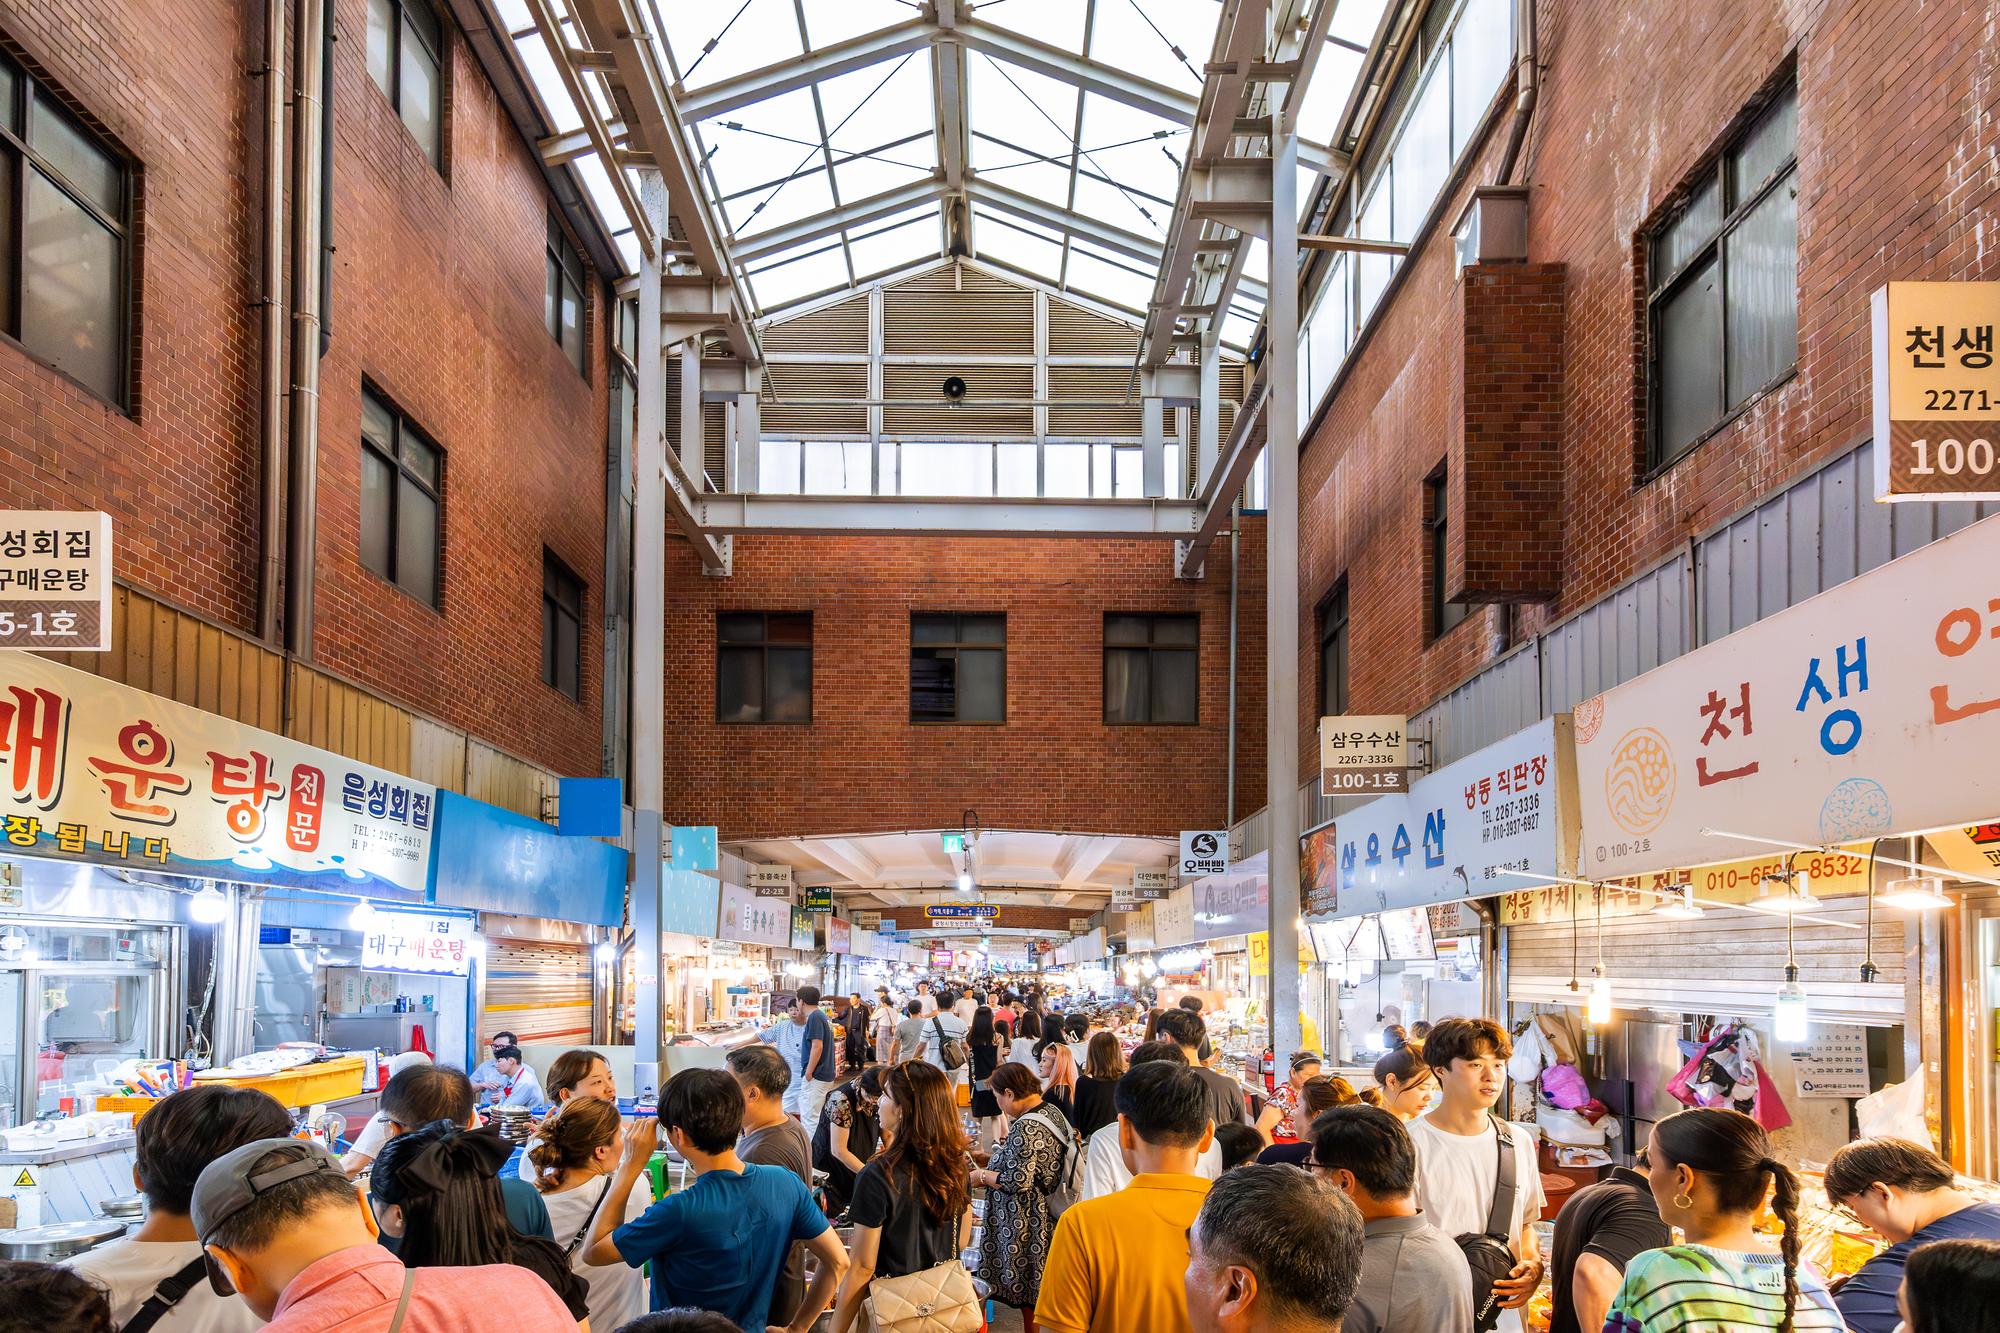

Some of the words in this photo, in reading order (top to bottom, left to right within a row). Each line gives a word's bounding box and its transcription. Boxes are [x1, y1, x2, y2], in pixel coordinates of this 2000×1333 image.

[1905, 325, 1994, 369] 천생
[0, 529, 91, 559] 성회집
[0, 609, 79, 636] 5-1호
[1331, 730, 1401, 749] 삼우수산
[1337, 754, 1394, 765] 2267-3336
[1332, 771, 1400, 788] 100-1호
[1464, 776, 1492, 811] 냉동
[1497, 753, 1548, 795] 직판장
[289, 771, 320, 847] 전문
[342, 771, 432, 832] 은성회집
[1495, 792, 1540, 821] 2267-3336
[1340, 807, 1446, 890] 삼우수산
[1611, 838, 1652, 858] 100-2호
[1184, 859, 1225, 873] 오백빵
[1143, 890, 1160, 898] 98호
[1505, 890, 1533, 921] 정읍
[1539, 883, 1570, 917] 김치
[1251, 939, 1266, 959] 다
